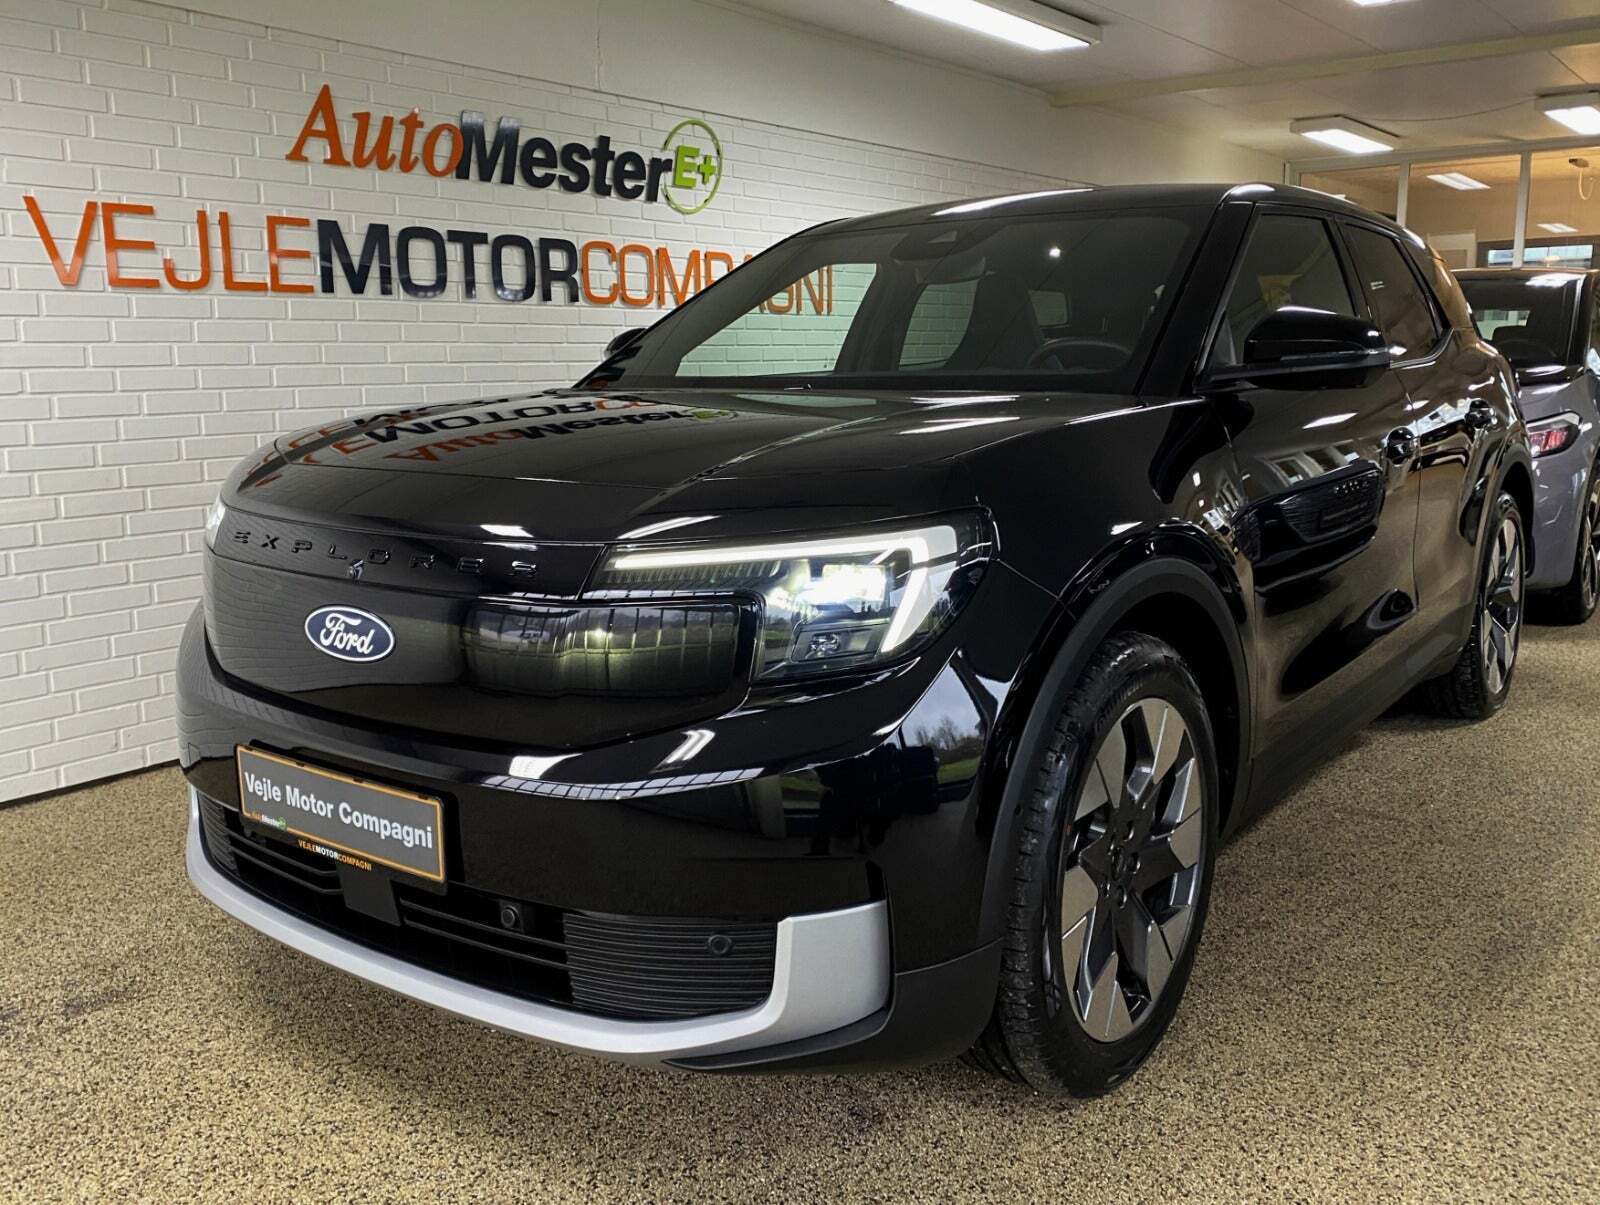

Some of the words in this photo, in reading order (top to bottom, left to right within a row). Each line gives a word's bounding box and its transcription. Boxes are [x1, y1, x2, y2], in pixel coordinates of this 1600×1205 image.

[286, 84, 672, 203] AutoMester
[233, 531, 538, 577] EXPLORER
[319, 612, 376, 655] Ford
[244, 771, 282, 803] Vejle
[286, 784, 334, 819] Motor
[339, 801, 433, 849] Compagni
